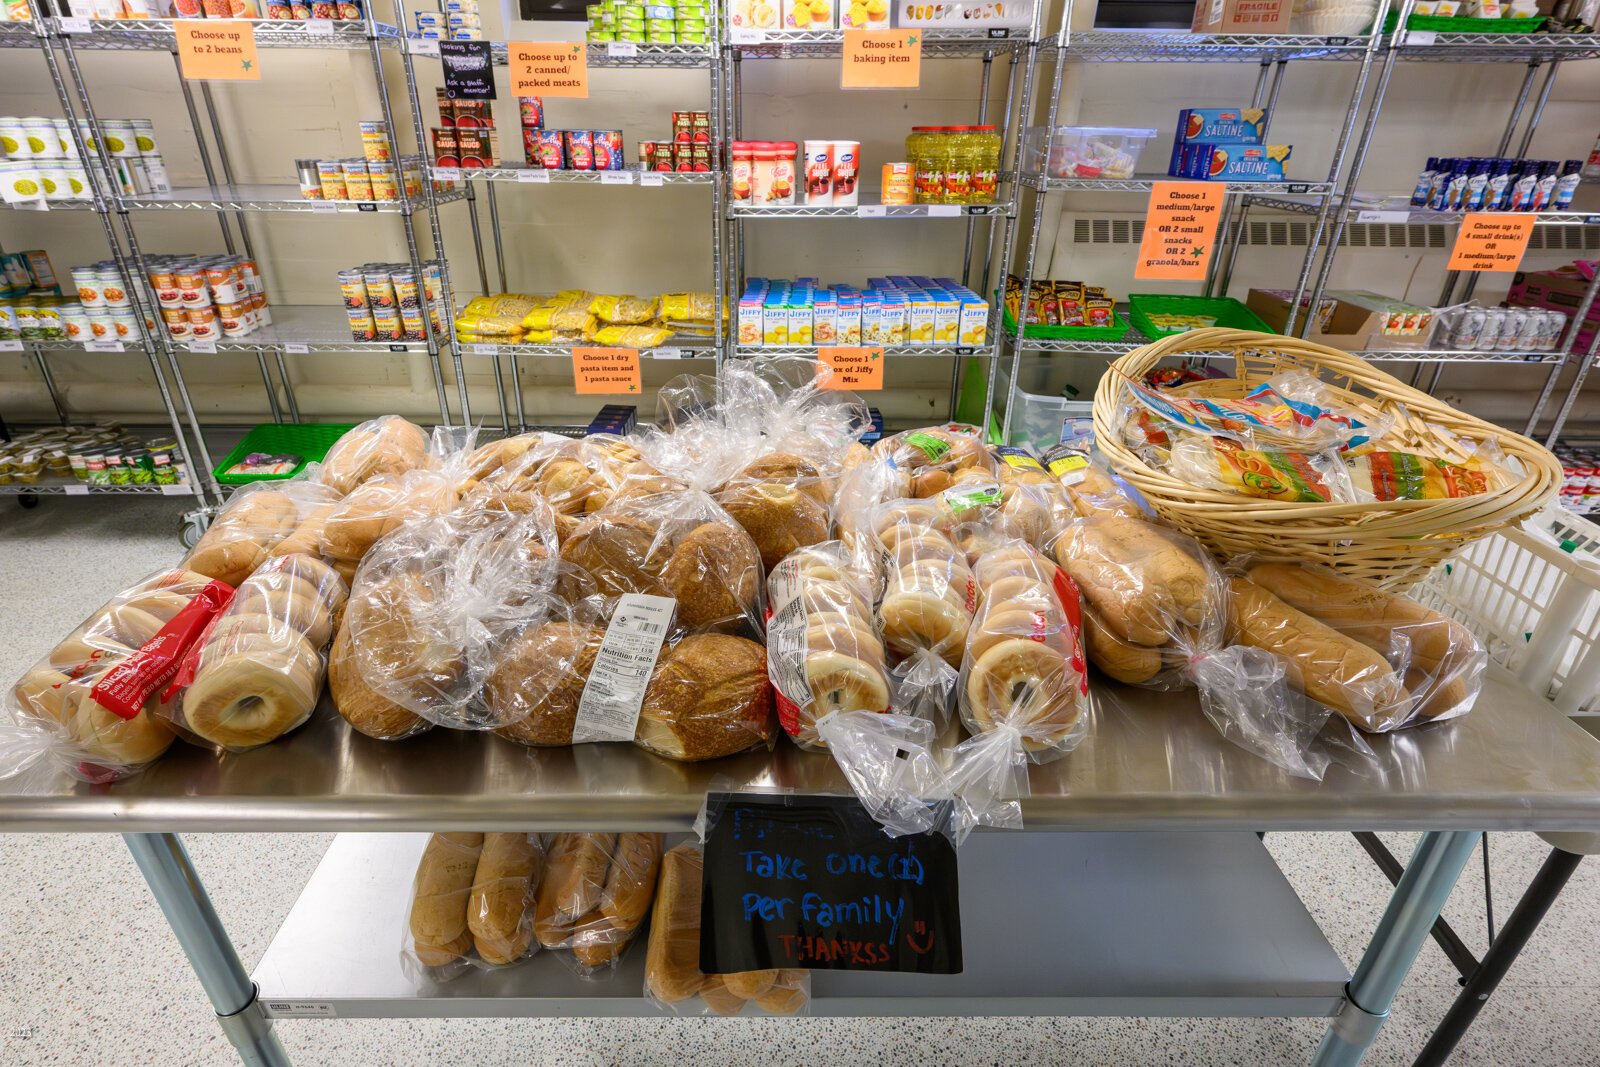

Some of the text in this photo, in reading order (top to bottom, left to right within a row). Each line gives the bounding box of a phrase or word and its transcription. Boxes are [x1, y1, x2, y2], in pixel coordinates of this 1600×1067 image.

[190, 30, 241, 41] Choose up
[441, 42, 482, 52] looking for
[862, 40, 896, 48] Choose
[194, 45, 243, 54] to 2 beans
[518, 52, 578, 63] Choose up to
[854, 54, 910, 64] baking item
[526, 65, 571, 75] 2 canned/
[518, 79, 550, 88] packed
[1204, 124, 1244, 137] SALTINE
[1228, 162, 1270, 174] SALTINE
[812, 169, 830, 178] sugar
[838, 169, 856, 178] sugar
[1170, 192, 1206, 200] Choose 1
[1156, 203, 1215, 212] medium/large
[1474, 222, 1500, 230] Choose
[1472, 232, 1492, 240] small
[1494, 233, 1524, 241] drink(s)
[1464, 252, 1516, 260] medium/large
[1473, 262, 1494, 270] drink
[740, 308, 762, 316] JIFFY
[764, 310, 786, 318] JIFFY
[790, 310, 812, 318] JIFFY
[856, 366, 873, 374] Jiffy
[602, 648, 633, 660] Nutrition
[634, 655, 653, 664] Facts
[98, 662, 129, 691] Sliced
[142, 636, 167, 654] Bagels
[597, 662, 619, 673] Calories
[108, 683, 124, 696] Fully
[142, 684, 156, 696] PESO
[739, 851, 808, 881] Take
